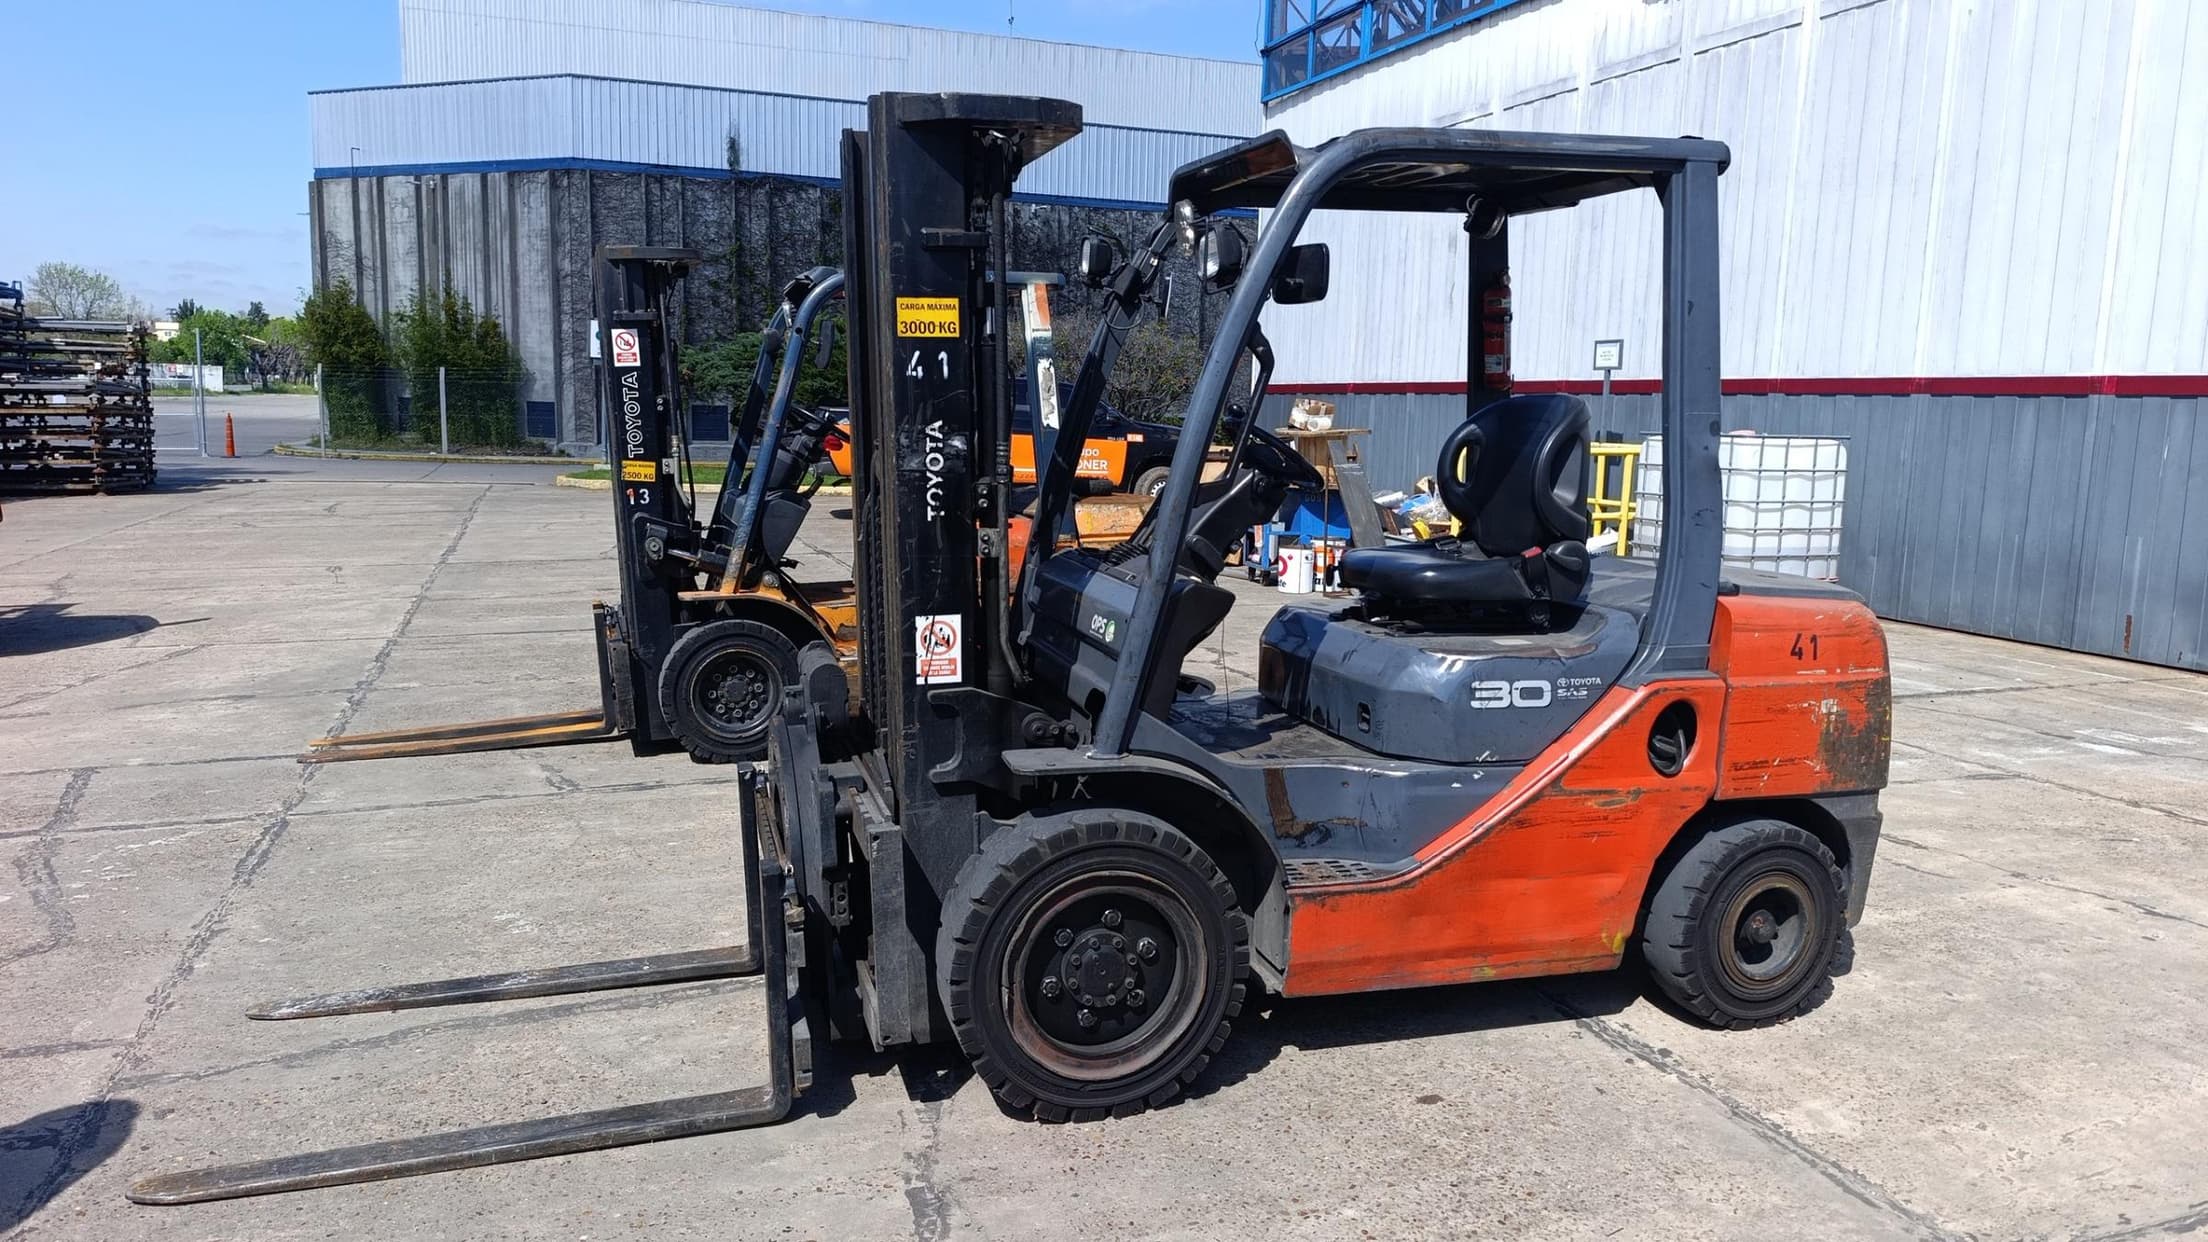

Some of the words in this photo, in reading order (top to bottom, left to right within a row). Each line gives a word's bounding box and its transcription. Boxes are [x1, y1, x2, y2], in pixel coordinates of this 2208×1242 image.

[900, 303, 925, 311] CARGA
[900, 320, 936, 334] 3000
[939, 321, 957, 334] KG
[621, 371, 644, 458] TOYOTA
[622, 471, 642, 480] 2500
[925, 420, 945, 522] TOYOTA
[1790, 633, 1819, 661] 41
[1570, 677, 1602, 686] TOYOTA
[1470, 680, 1552, 709] 30
